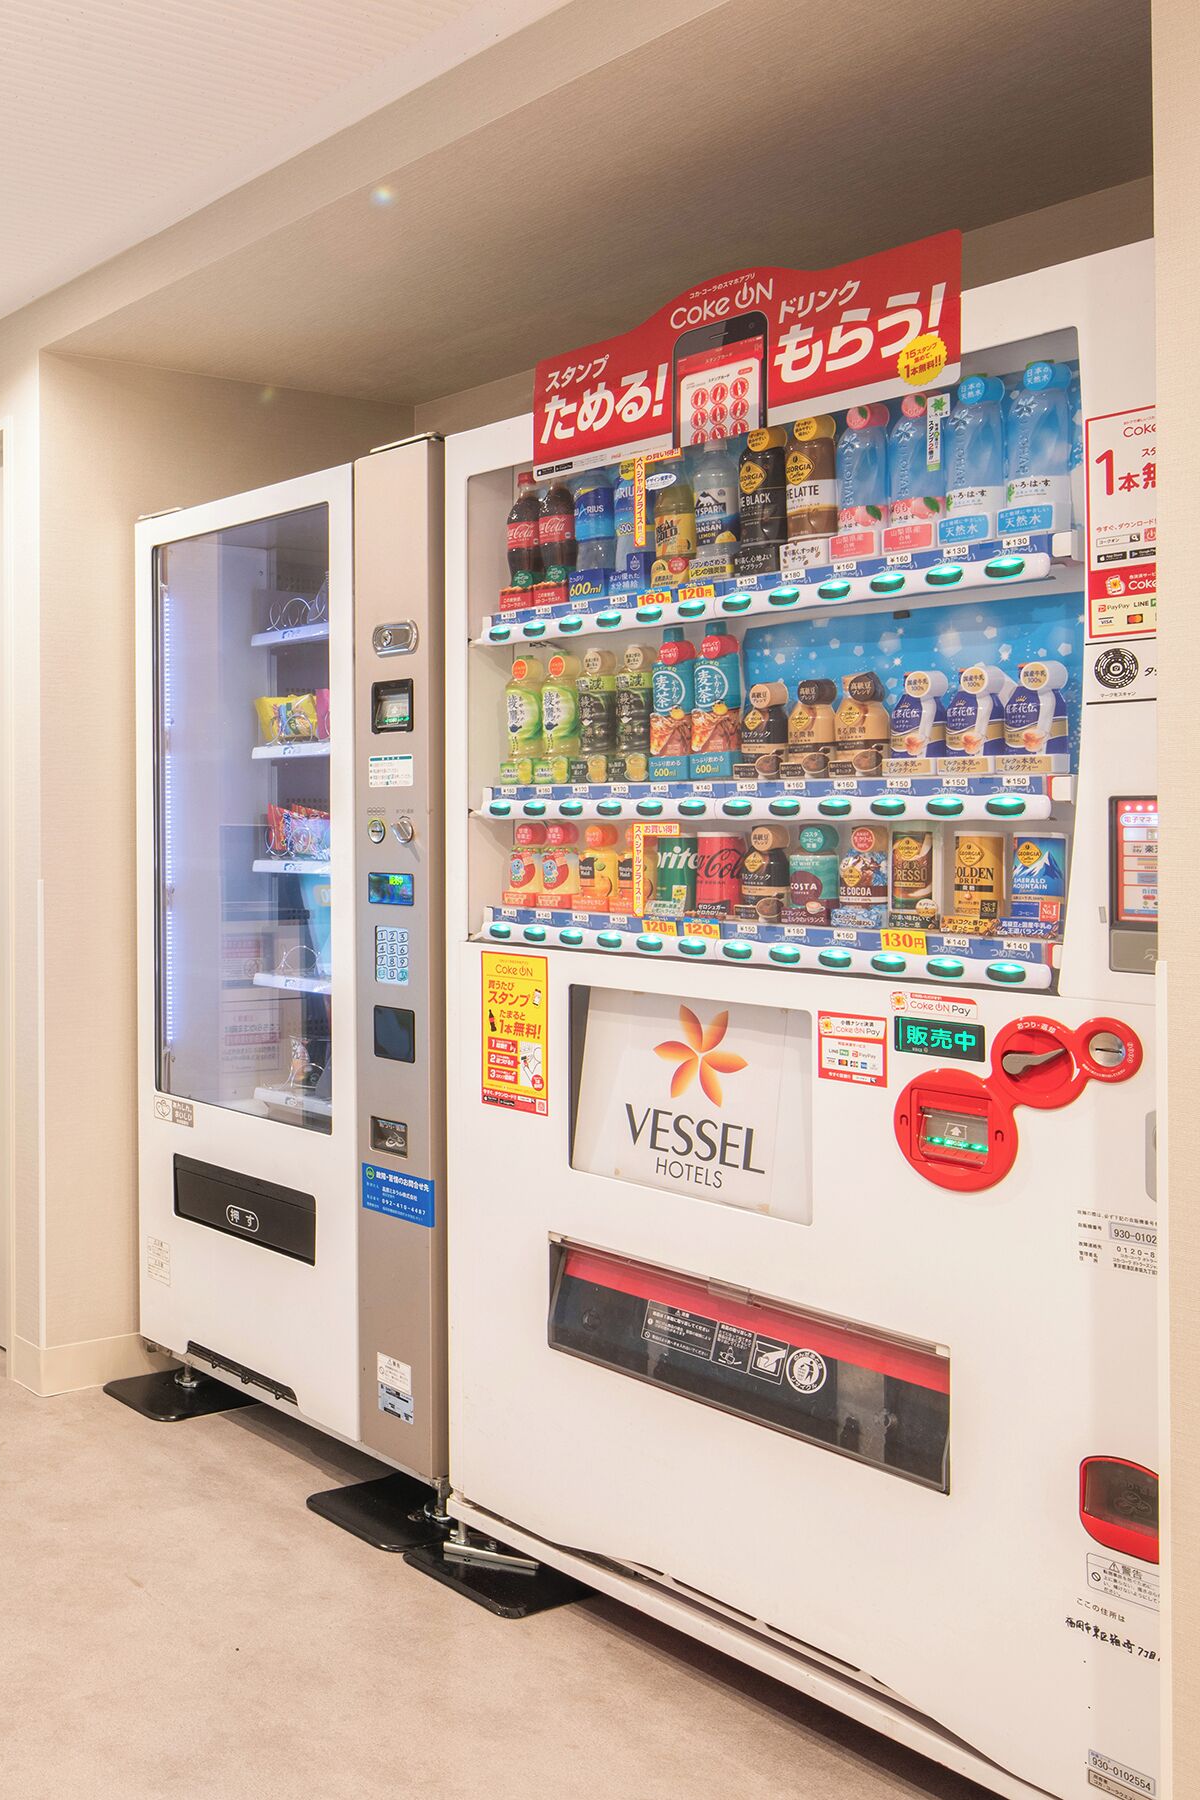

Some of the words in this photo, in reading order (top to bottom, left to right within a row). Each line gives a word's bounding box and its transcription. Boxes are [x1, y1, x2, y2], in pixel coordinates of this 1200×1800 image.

[670, 297, 730, 330] Coke
[735, 279, 774, 309] ON
[778, 280, 861, 324] ドリンク
[545, 354, 610, 393] スタンプ
[904, 355, 942, 379] 1本無料!!
[540, 362, 669, 445] ためる!
[794, 485, 820, 498] LATTE
[746, 492, 771, 506] BLACK
[1005, 514, 1041, 528] 天然水
[656, 528, 679, 542] GOLD
[945, 525, 979, 538] 天然水
[1006, 537, 1028, 546] ¥130
[946, 547, 967, 556] ¥130
[890, 555, 909, 563] ¥160
[569, 582, 602, 597] 600ml
[680, 587, 713, 600] 120円
[638, 593, 671, 606] 160円
[1023, 670, 1046, 678] 国産牛乳
[655, 675, 670, 708] 麦茶
[697, 669, 712, 703] 麦茶
[1006, 777, 1027, 785] ¥150
[791, 882, 817, 891] COSTA
[847, 887, 872, 896] COCOA
[645, 921, 675, 933] 120円
[685, 923, 718, 936] 120円
[883, 932, 924, 948] 130円
[495, 963, 517, 976] Coke
[488, 980, 514, 991] 買うたび
[488, 990, 530, 1008] スタンプ
[500, 1009, 526, 1021] たまると
[910, 1001, 933, 1011] Coke
[935, 1003, 950, 1013] ON
[951, 1005, 971, 1016] Pay
[499, 1020, 541, 1039] 1本無料!
[835, 1026, 853, 1034] Coke
[866, 1028, 880, 1037] Pay
[906, 1025, 976, 1052] 販売中
[625, 1103, 765, 1175] VESSEL
[656, 1156, 723, 1189] HOTELS
[230, 1208, 254, 1227] 押す
[1076, 1597, 1125, 1622] ここの住所は
[1092, 1756, 1151, 1791] 930-0102554
